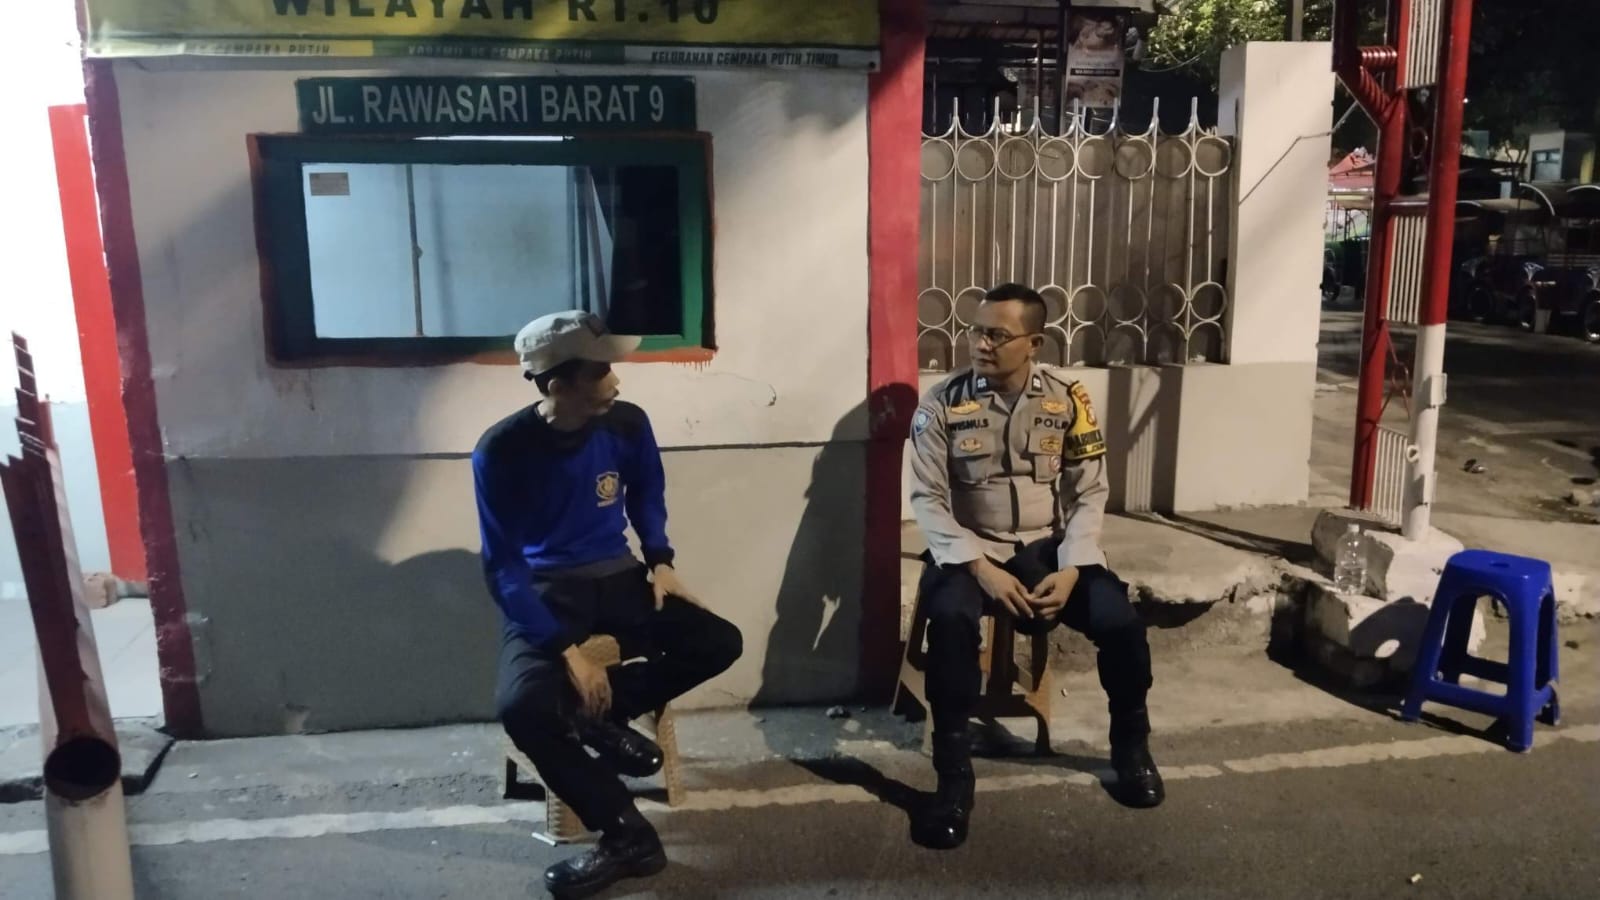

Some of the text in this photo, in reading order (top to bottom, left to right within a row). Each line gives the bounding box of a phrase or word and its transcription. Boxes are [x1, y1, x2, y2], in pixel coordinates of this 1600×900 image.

[273, 0, 533, 20] WILAYAH
[717, 52, 768, 66] CEMPAKA
[771, 52, 801, 66] PUTIH
[312, 84, 664, 124] JL. RAWASARI BARAT 9
[1033, 416, 1070, 431] POLR
